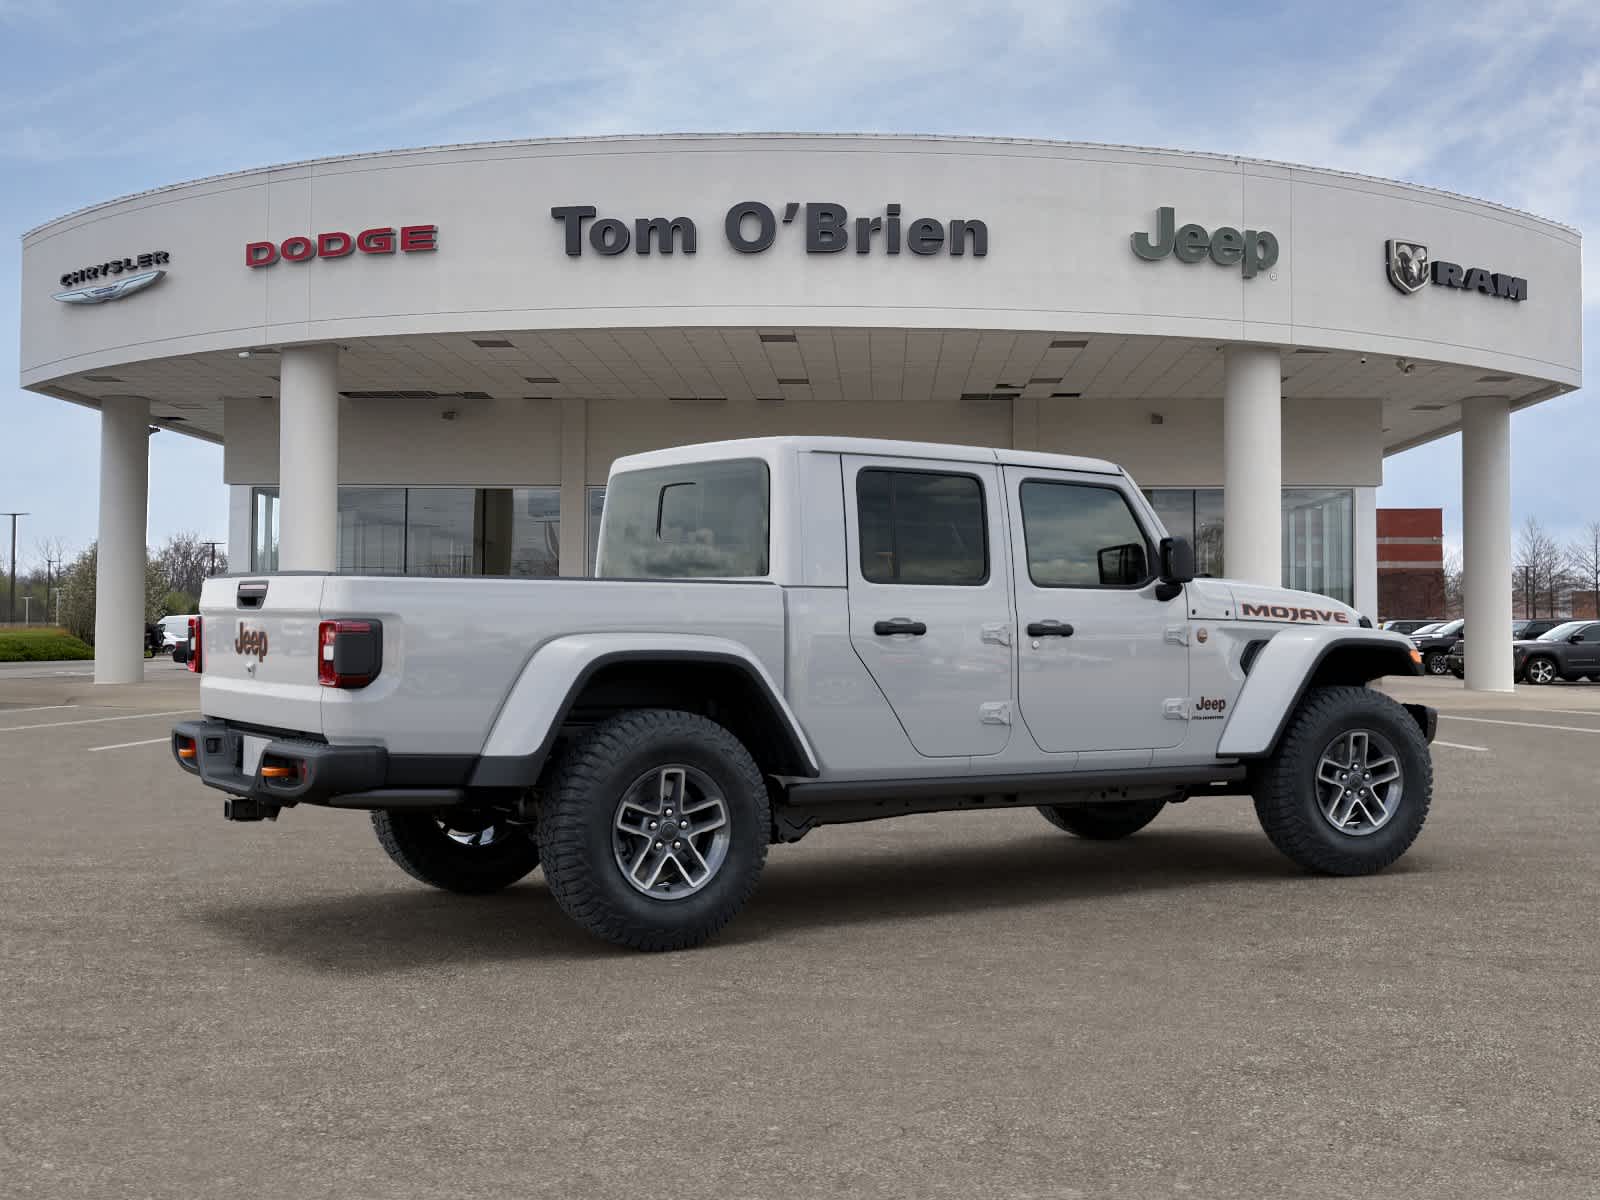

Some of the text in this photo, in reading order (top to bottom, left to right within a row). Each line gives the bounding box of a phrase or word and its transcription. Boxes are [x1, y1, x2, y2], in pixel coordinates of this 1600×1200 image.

[245, 224, 438, 269] DODGE
[550, 204, 697, 256] Tom
[1130, 206, 1279, 279] Jeep
[60, 250, 170, 287] CHRYSLER
[1430, 260, 1528, 302] RAM
[1241, 603, 1349, 624] MOJAVE
[234, 621, 268, 663] Jeep
[1195, 696, 1226, 712] Jeep
